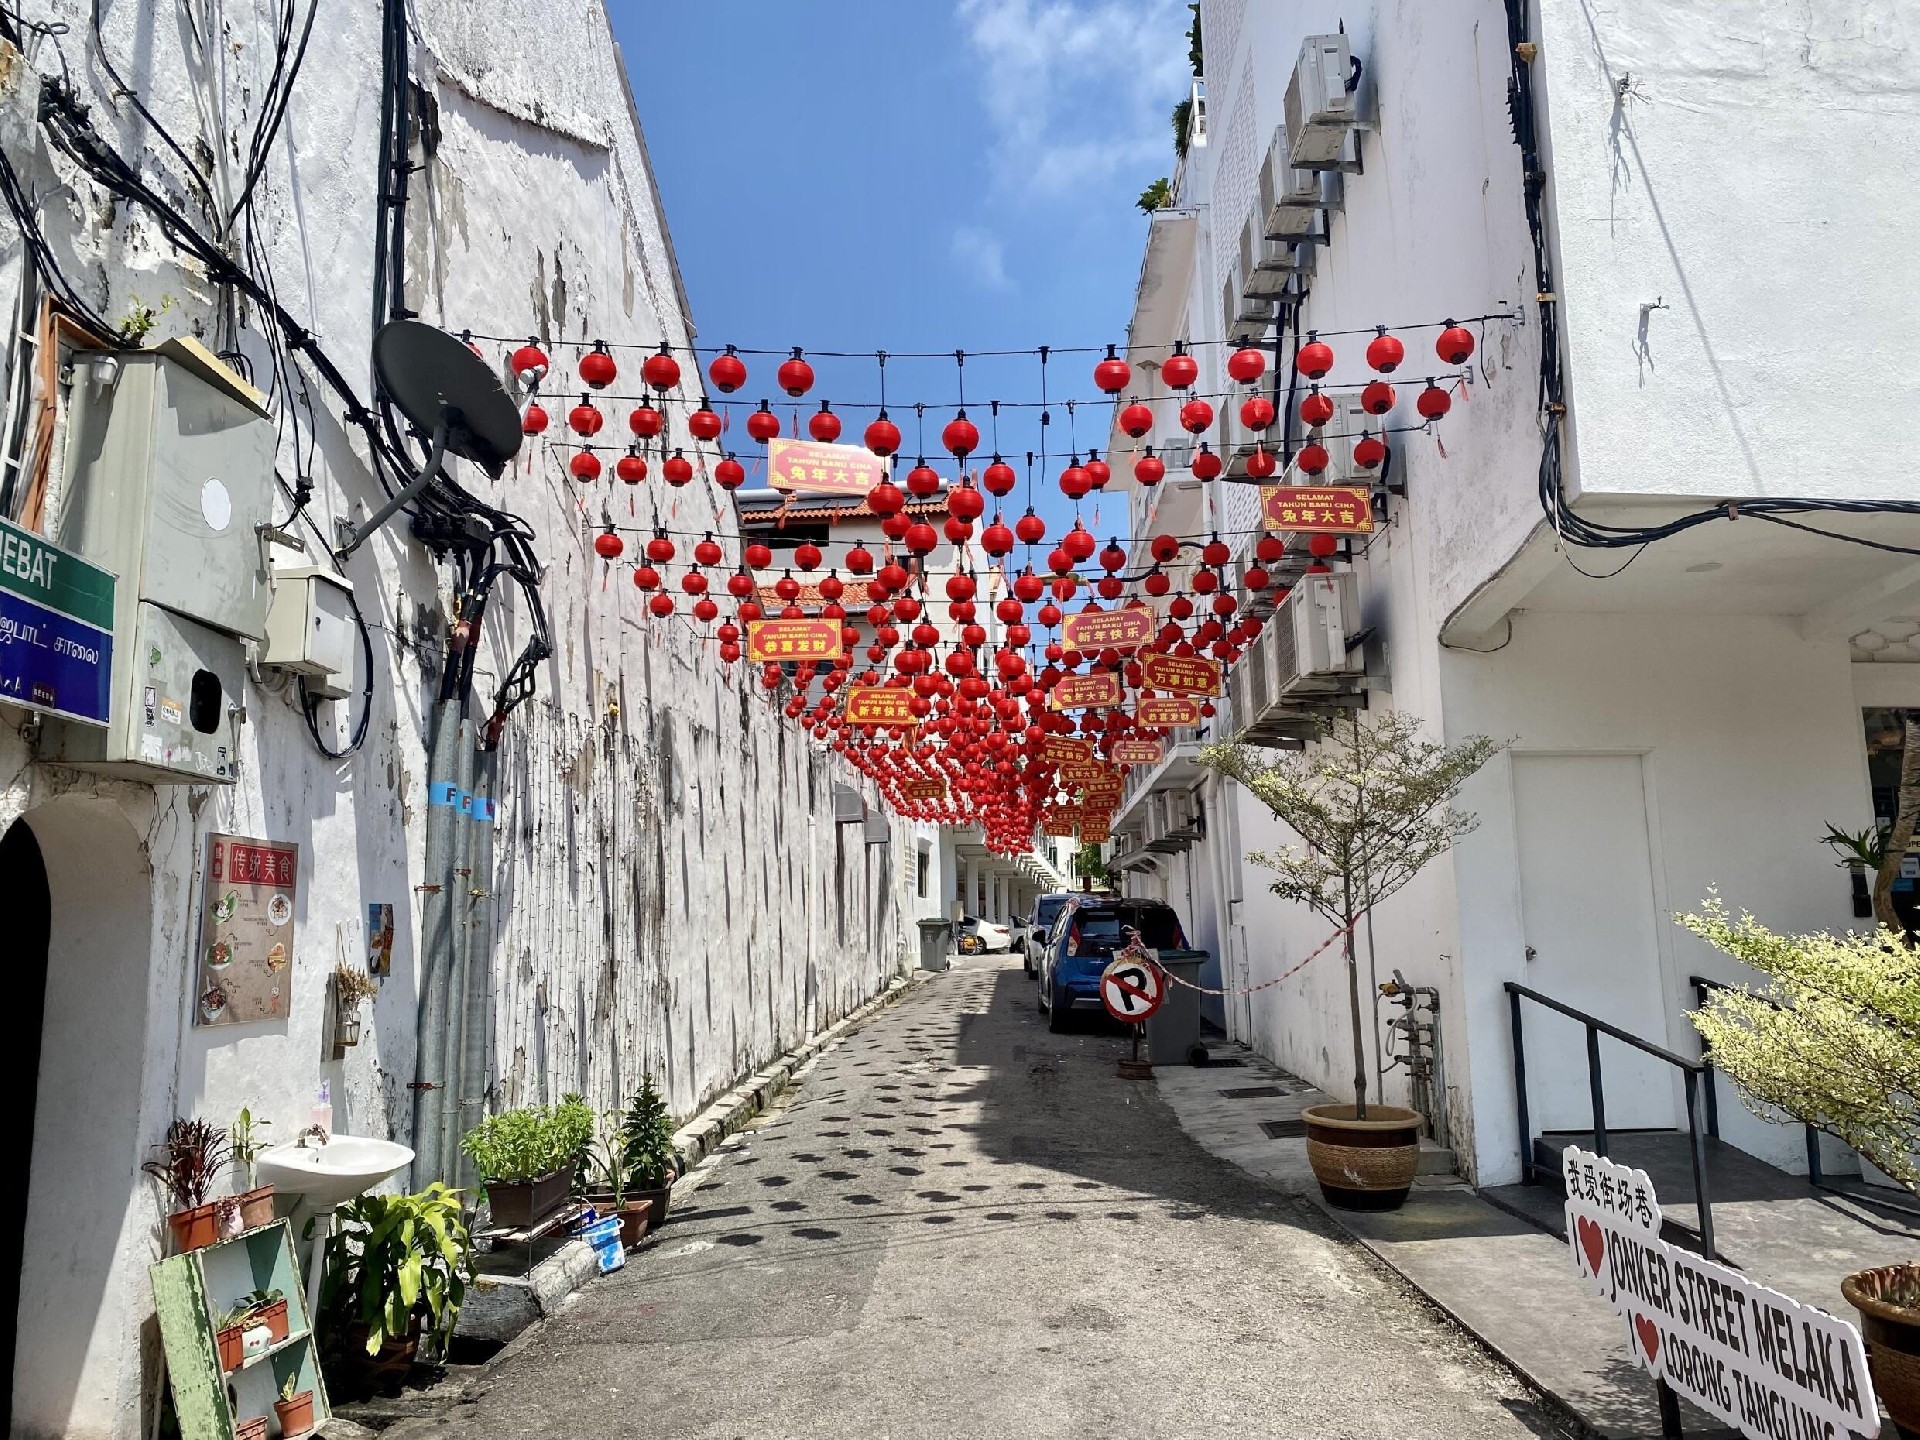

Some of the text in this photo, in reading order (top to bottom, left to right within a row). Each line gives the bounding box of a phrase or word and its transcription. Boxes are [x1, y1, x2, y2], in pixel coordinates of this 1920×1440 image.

[787, 457, 819, 466] TAHUN
[821, 460, 847, 468] BARU
[808, 451, 852, 460] SELAMAT
[790, 465, 870, 485] 兔年大吉
[1282, 509, 1355, 523] 兔年大吉
[1091, 616, 1124, 624] SELAMAT
[1077, 627, 1139, 642] 新年快乐
[764, 640, 826, 653] 恭喜发财
[1168, 661, 1195, 669] SELAMAT
[1156, 673, 1207, 688] 万事如意
[859, 705, 908, 717] 新年快乐
[233, 849, 291, 881] 传统美食
[1113, 967, 1147, 1012] P
[1571, 1212, 1863, 1420] I JONKER STREET MELAKA
[1627, 1309, 1637, 1355] I
[1660, 1327, 1732, 1413] LORONG
